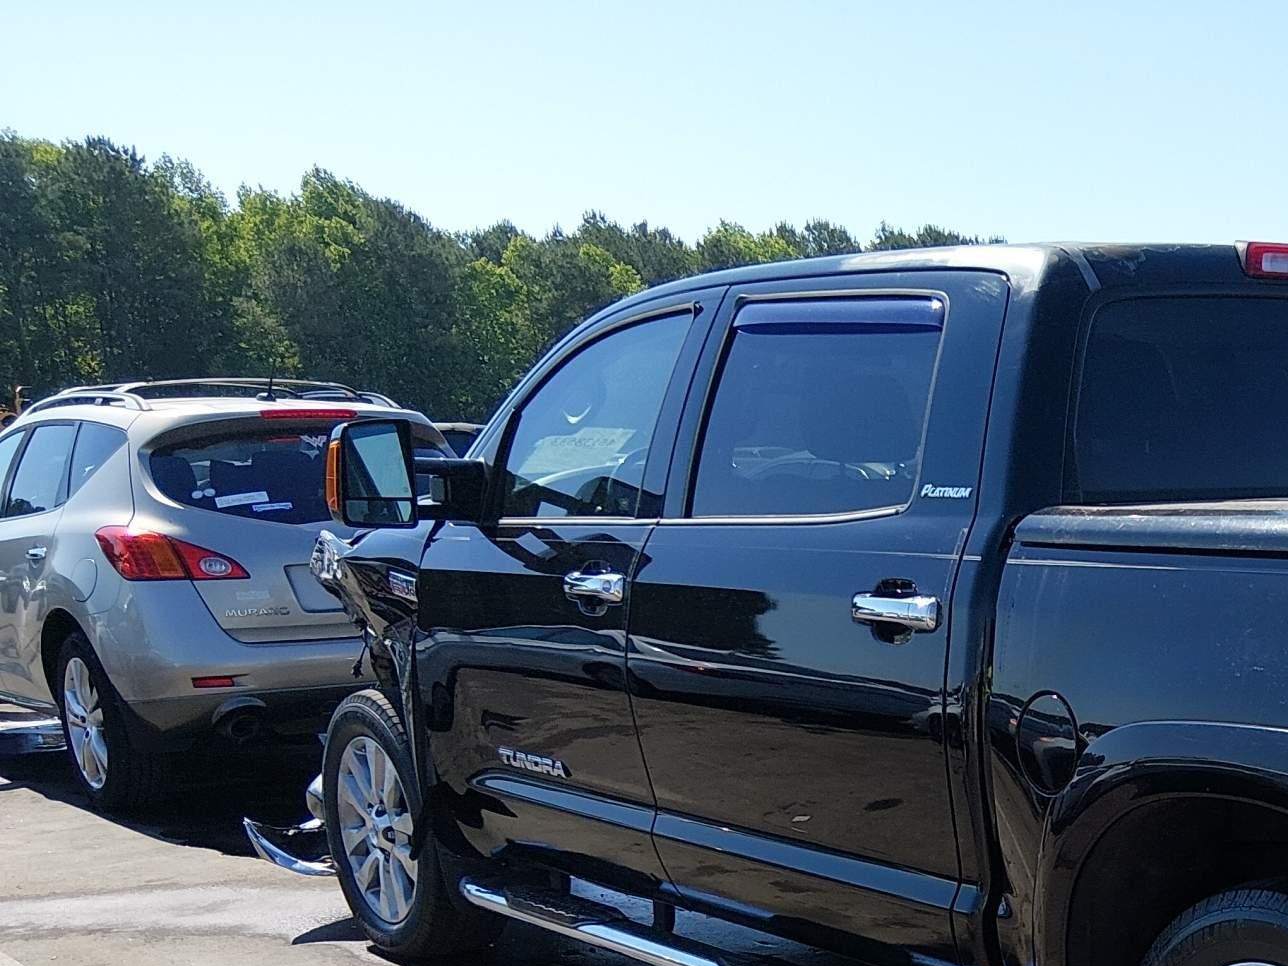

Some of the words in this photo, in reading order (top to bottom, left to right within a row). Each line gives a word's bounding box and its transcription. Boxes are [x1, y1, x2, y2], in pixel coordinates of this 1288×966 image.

[921, 483, 973, 498] PLATINUM
[225, 607, 291, 617] MURANO
[497, 745, 570, 779] TUNDRA
